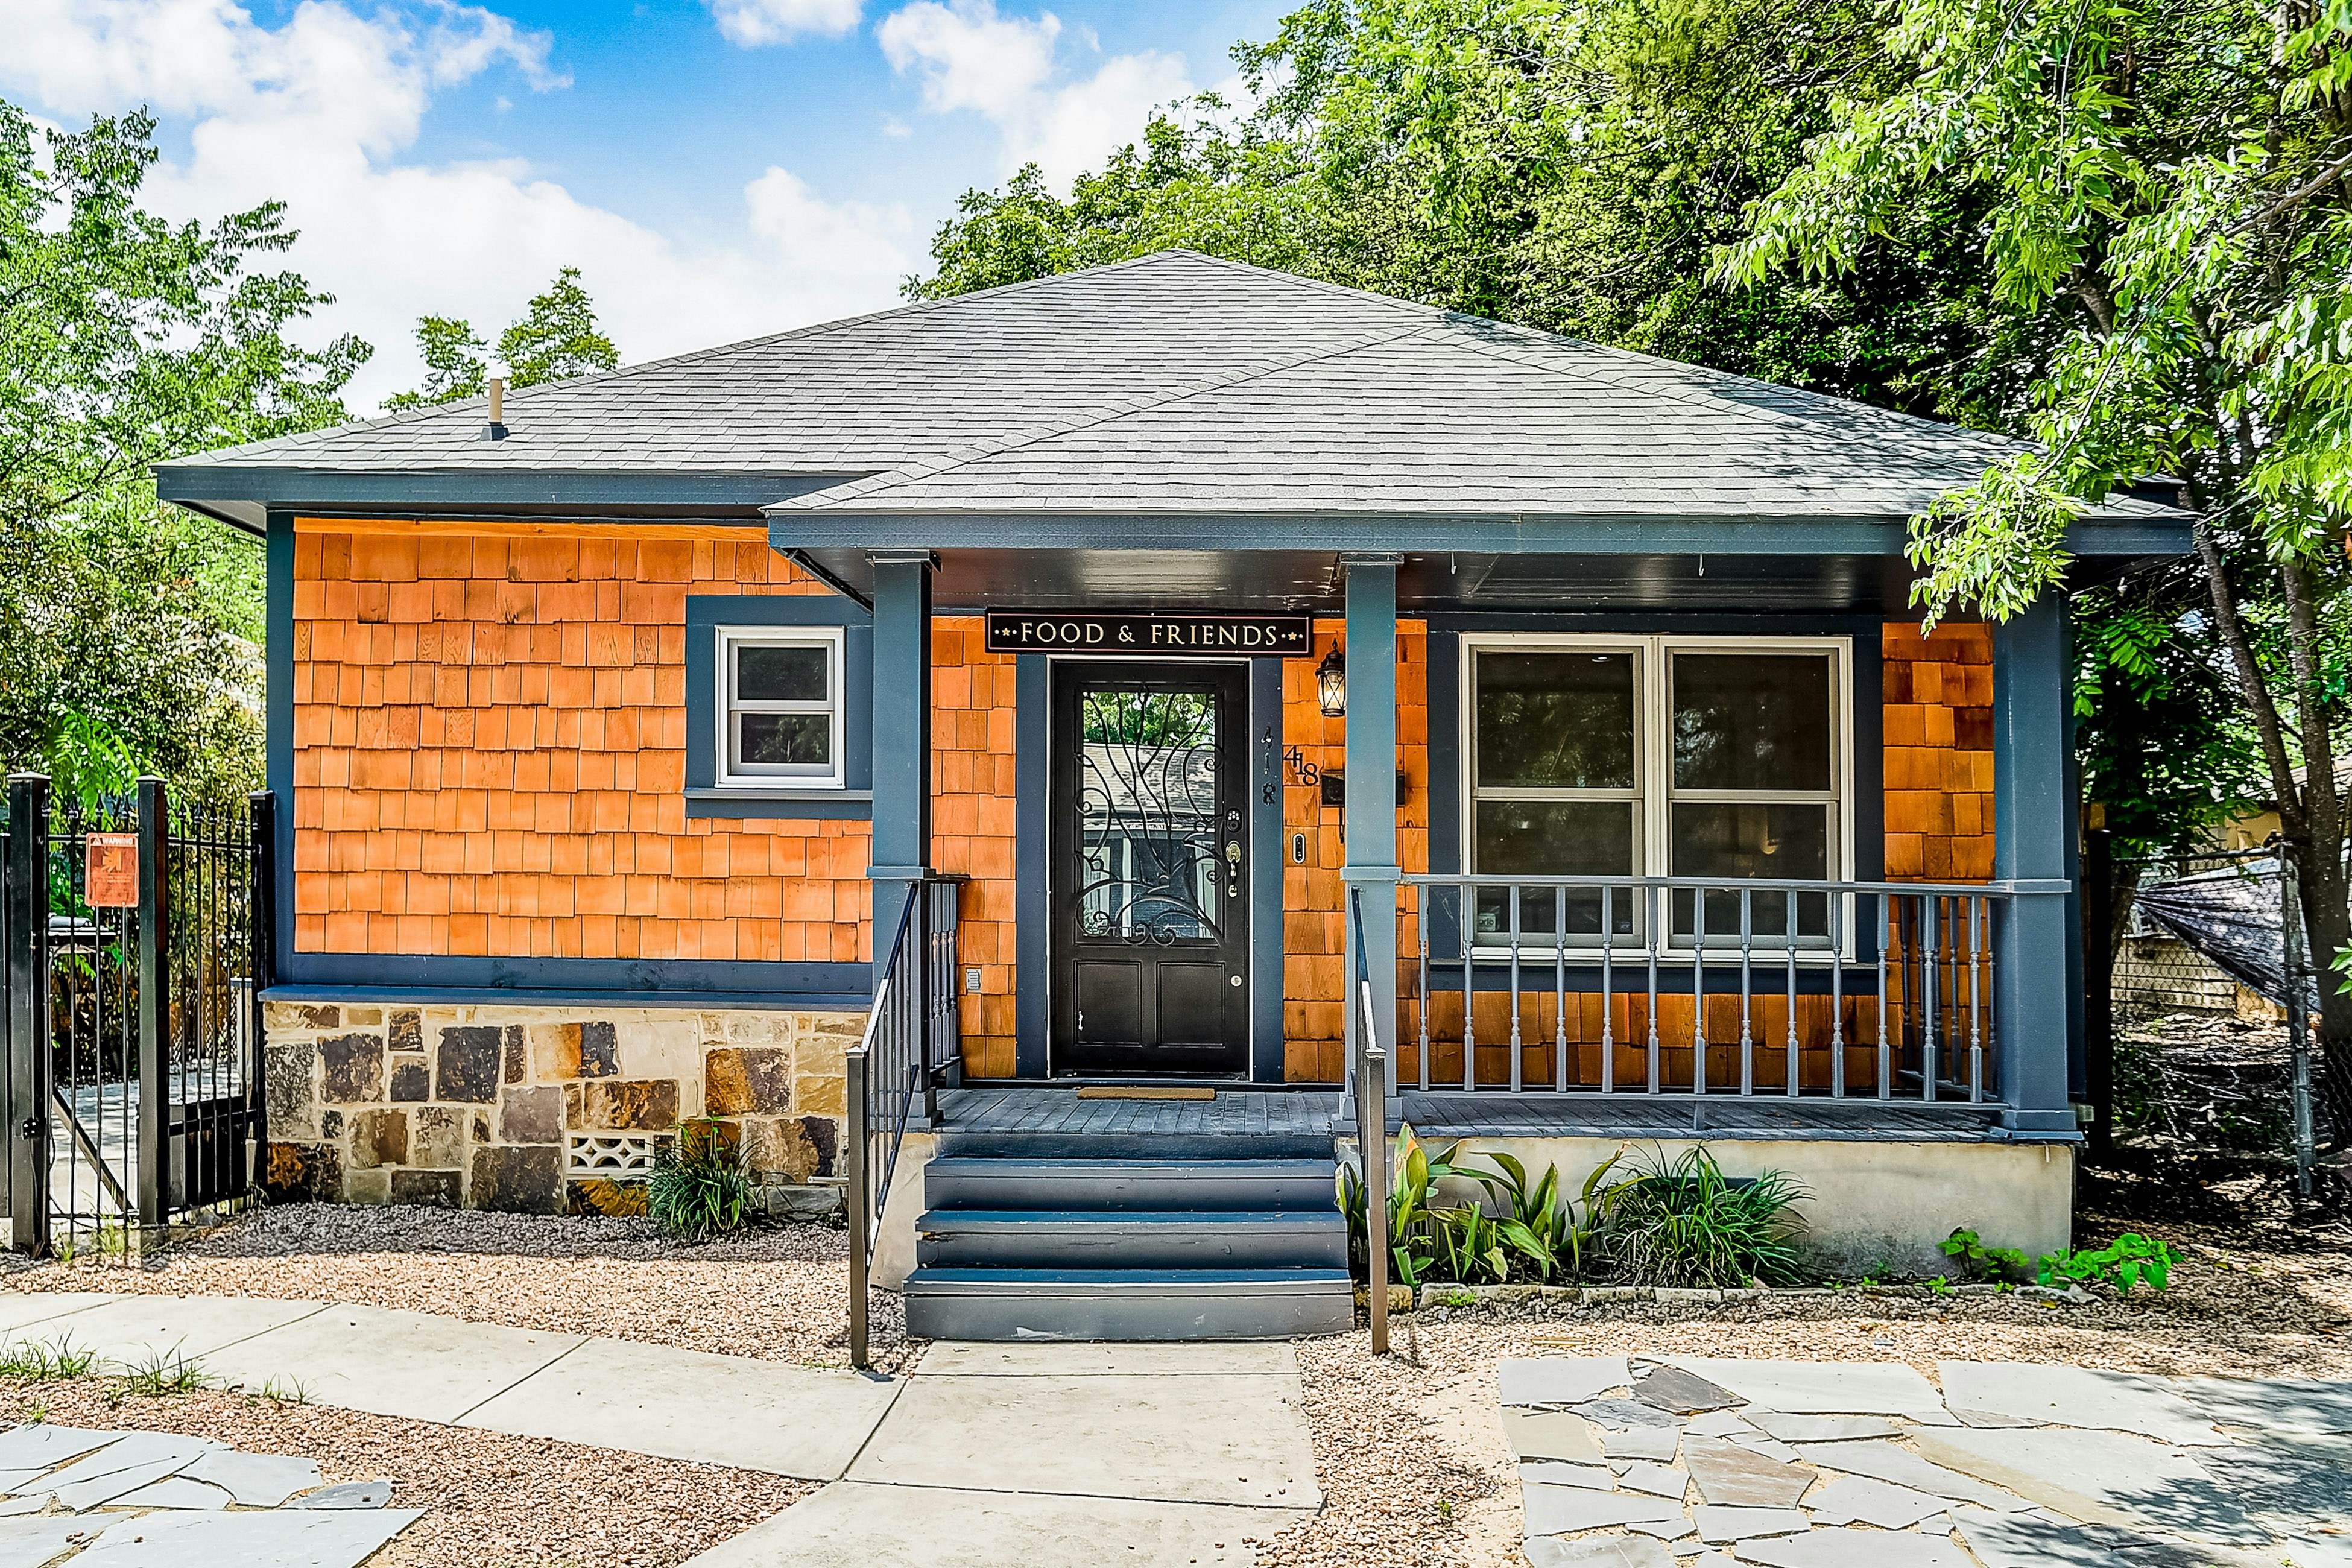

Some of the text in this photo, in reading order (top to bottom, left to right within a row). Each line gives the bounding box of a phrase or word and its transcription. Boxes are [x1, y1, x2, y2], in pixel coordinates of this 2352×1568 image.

[1020, 622, 1277, 646] FOOD & FRIENDS
[1260, 726, 1276, 805] 418
[1283, 745, 1318, 786] 418
[102, 836, 133, 845] WARNING
